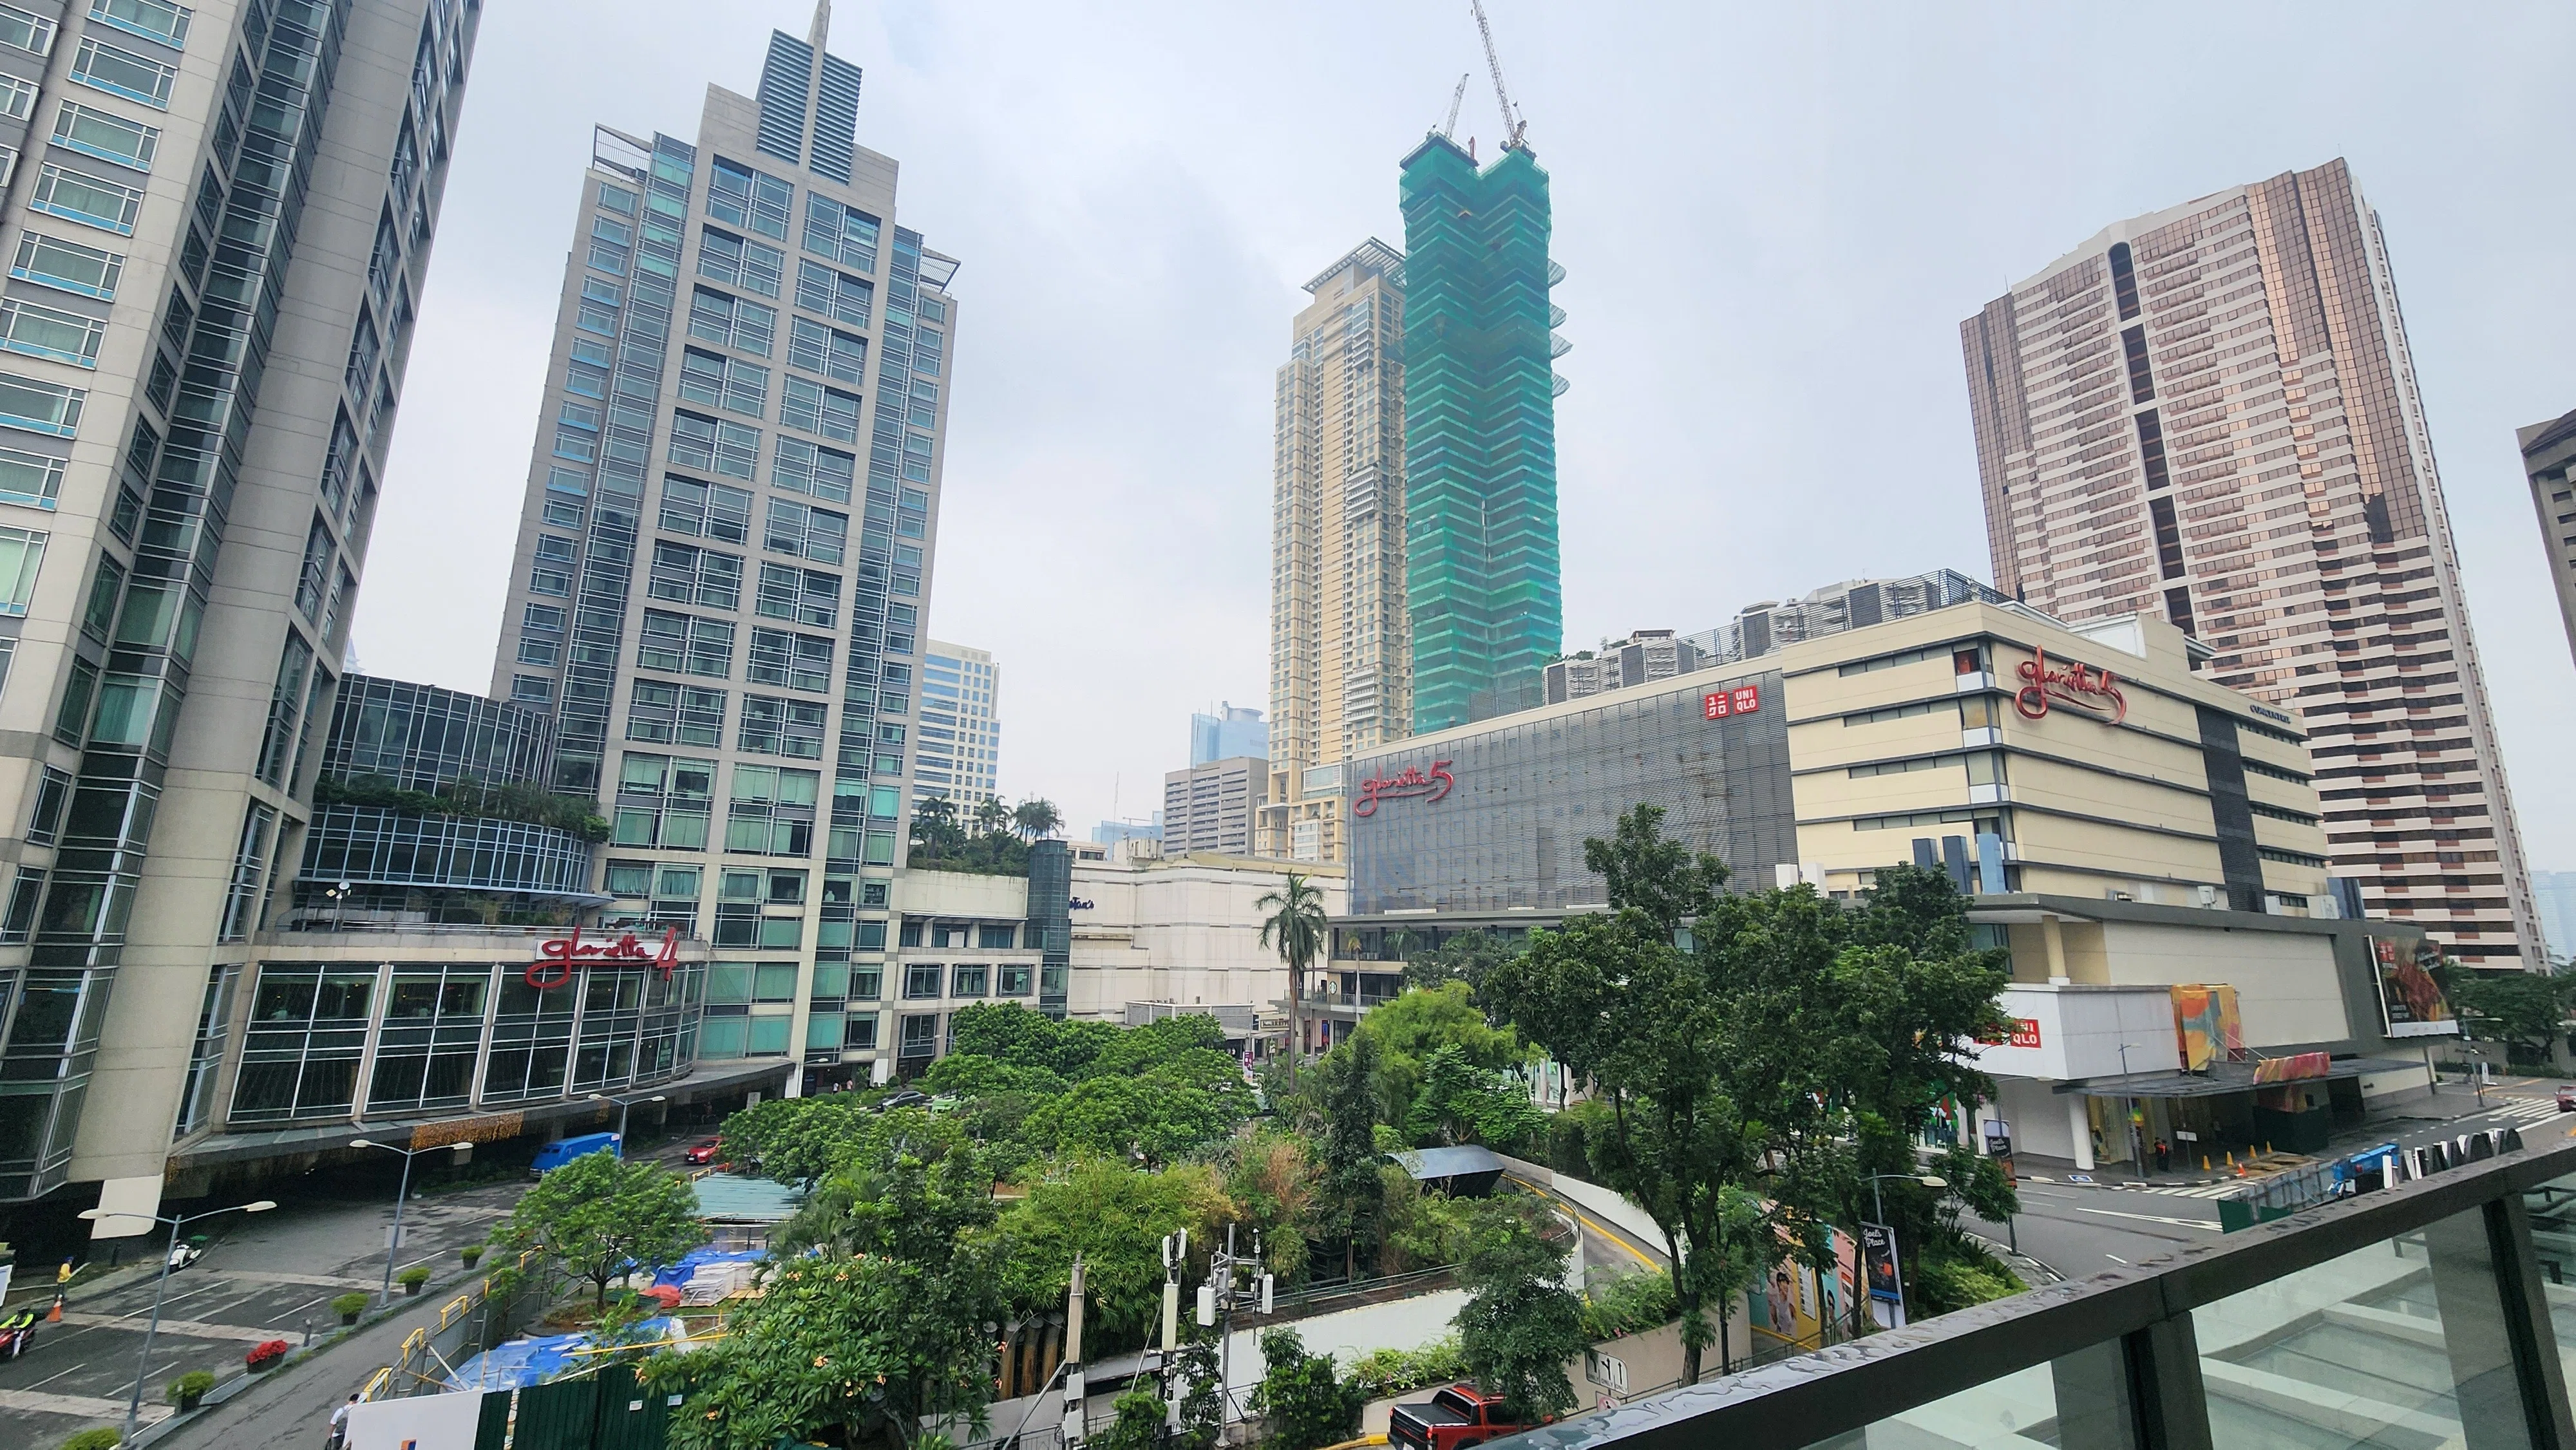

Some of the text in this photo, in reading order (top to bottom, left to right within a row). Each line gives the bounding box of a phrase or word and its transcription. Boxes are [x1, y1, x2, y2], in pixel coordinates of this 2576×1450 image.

[2015, 645, 2110, 719] glorietta
[1735, 689, 1754, 700] UNI
[1708, 695, 1726, 706] ユニ
[1736, 699, 1756, 711] QLO
[1709, 705, 1727, 716] クロ
[1354, 760, 1454, 816] glorietta 5
[525, 924, 679, 988] glorietta 4
[2013, 1033, 2038, 1045] QLO
[1863, 1229, 1882, 1240] Joel's
[1865, 1238, 1886, 1248] Place
